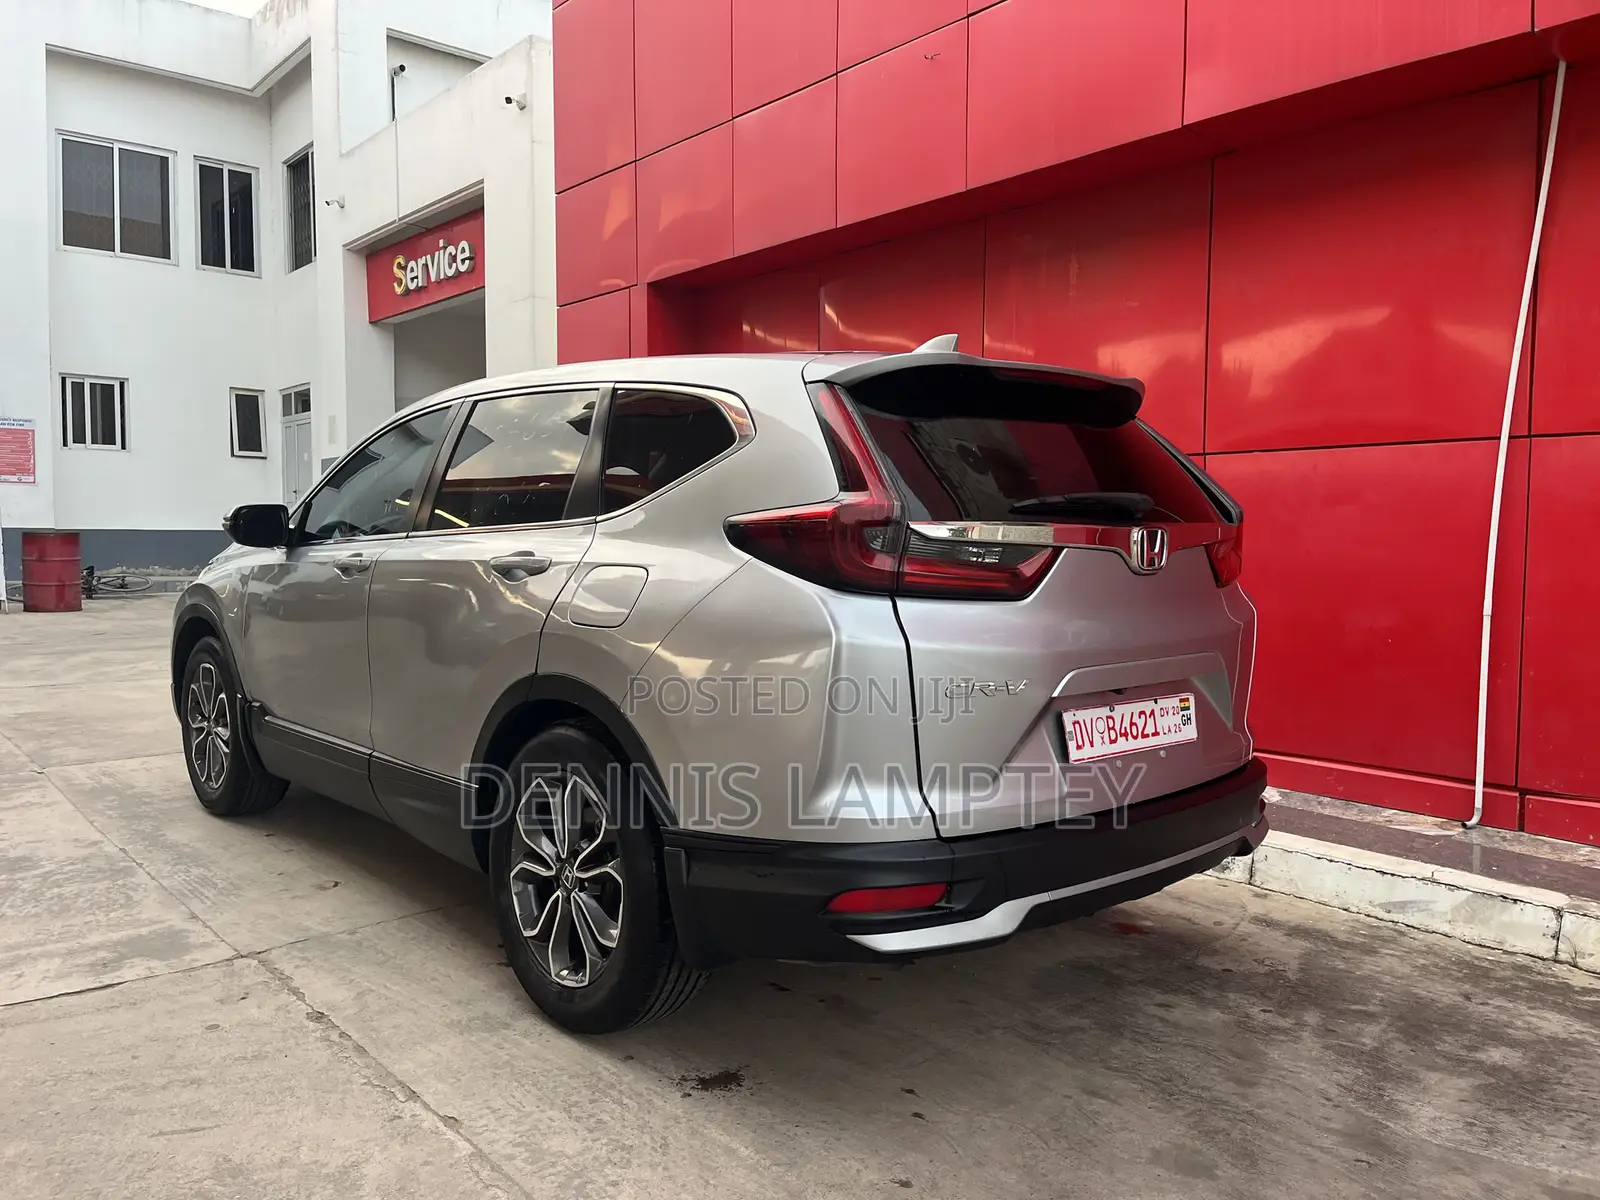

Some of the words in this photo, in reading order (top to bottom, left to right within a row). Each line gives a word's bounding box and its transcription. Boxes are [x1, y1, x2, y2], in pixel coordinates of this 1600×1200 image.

[393, 239, 475, 295] Service
[944, 679, 1030, 699] CR-V
[1106, 708, 1161, 745] B4621
[1180, 712, 1193, 727] GH
[1161, 725, 1173, 736] LA
